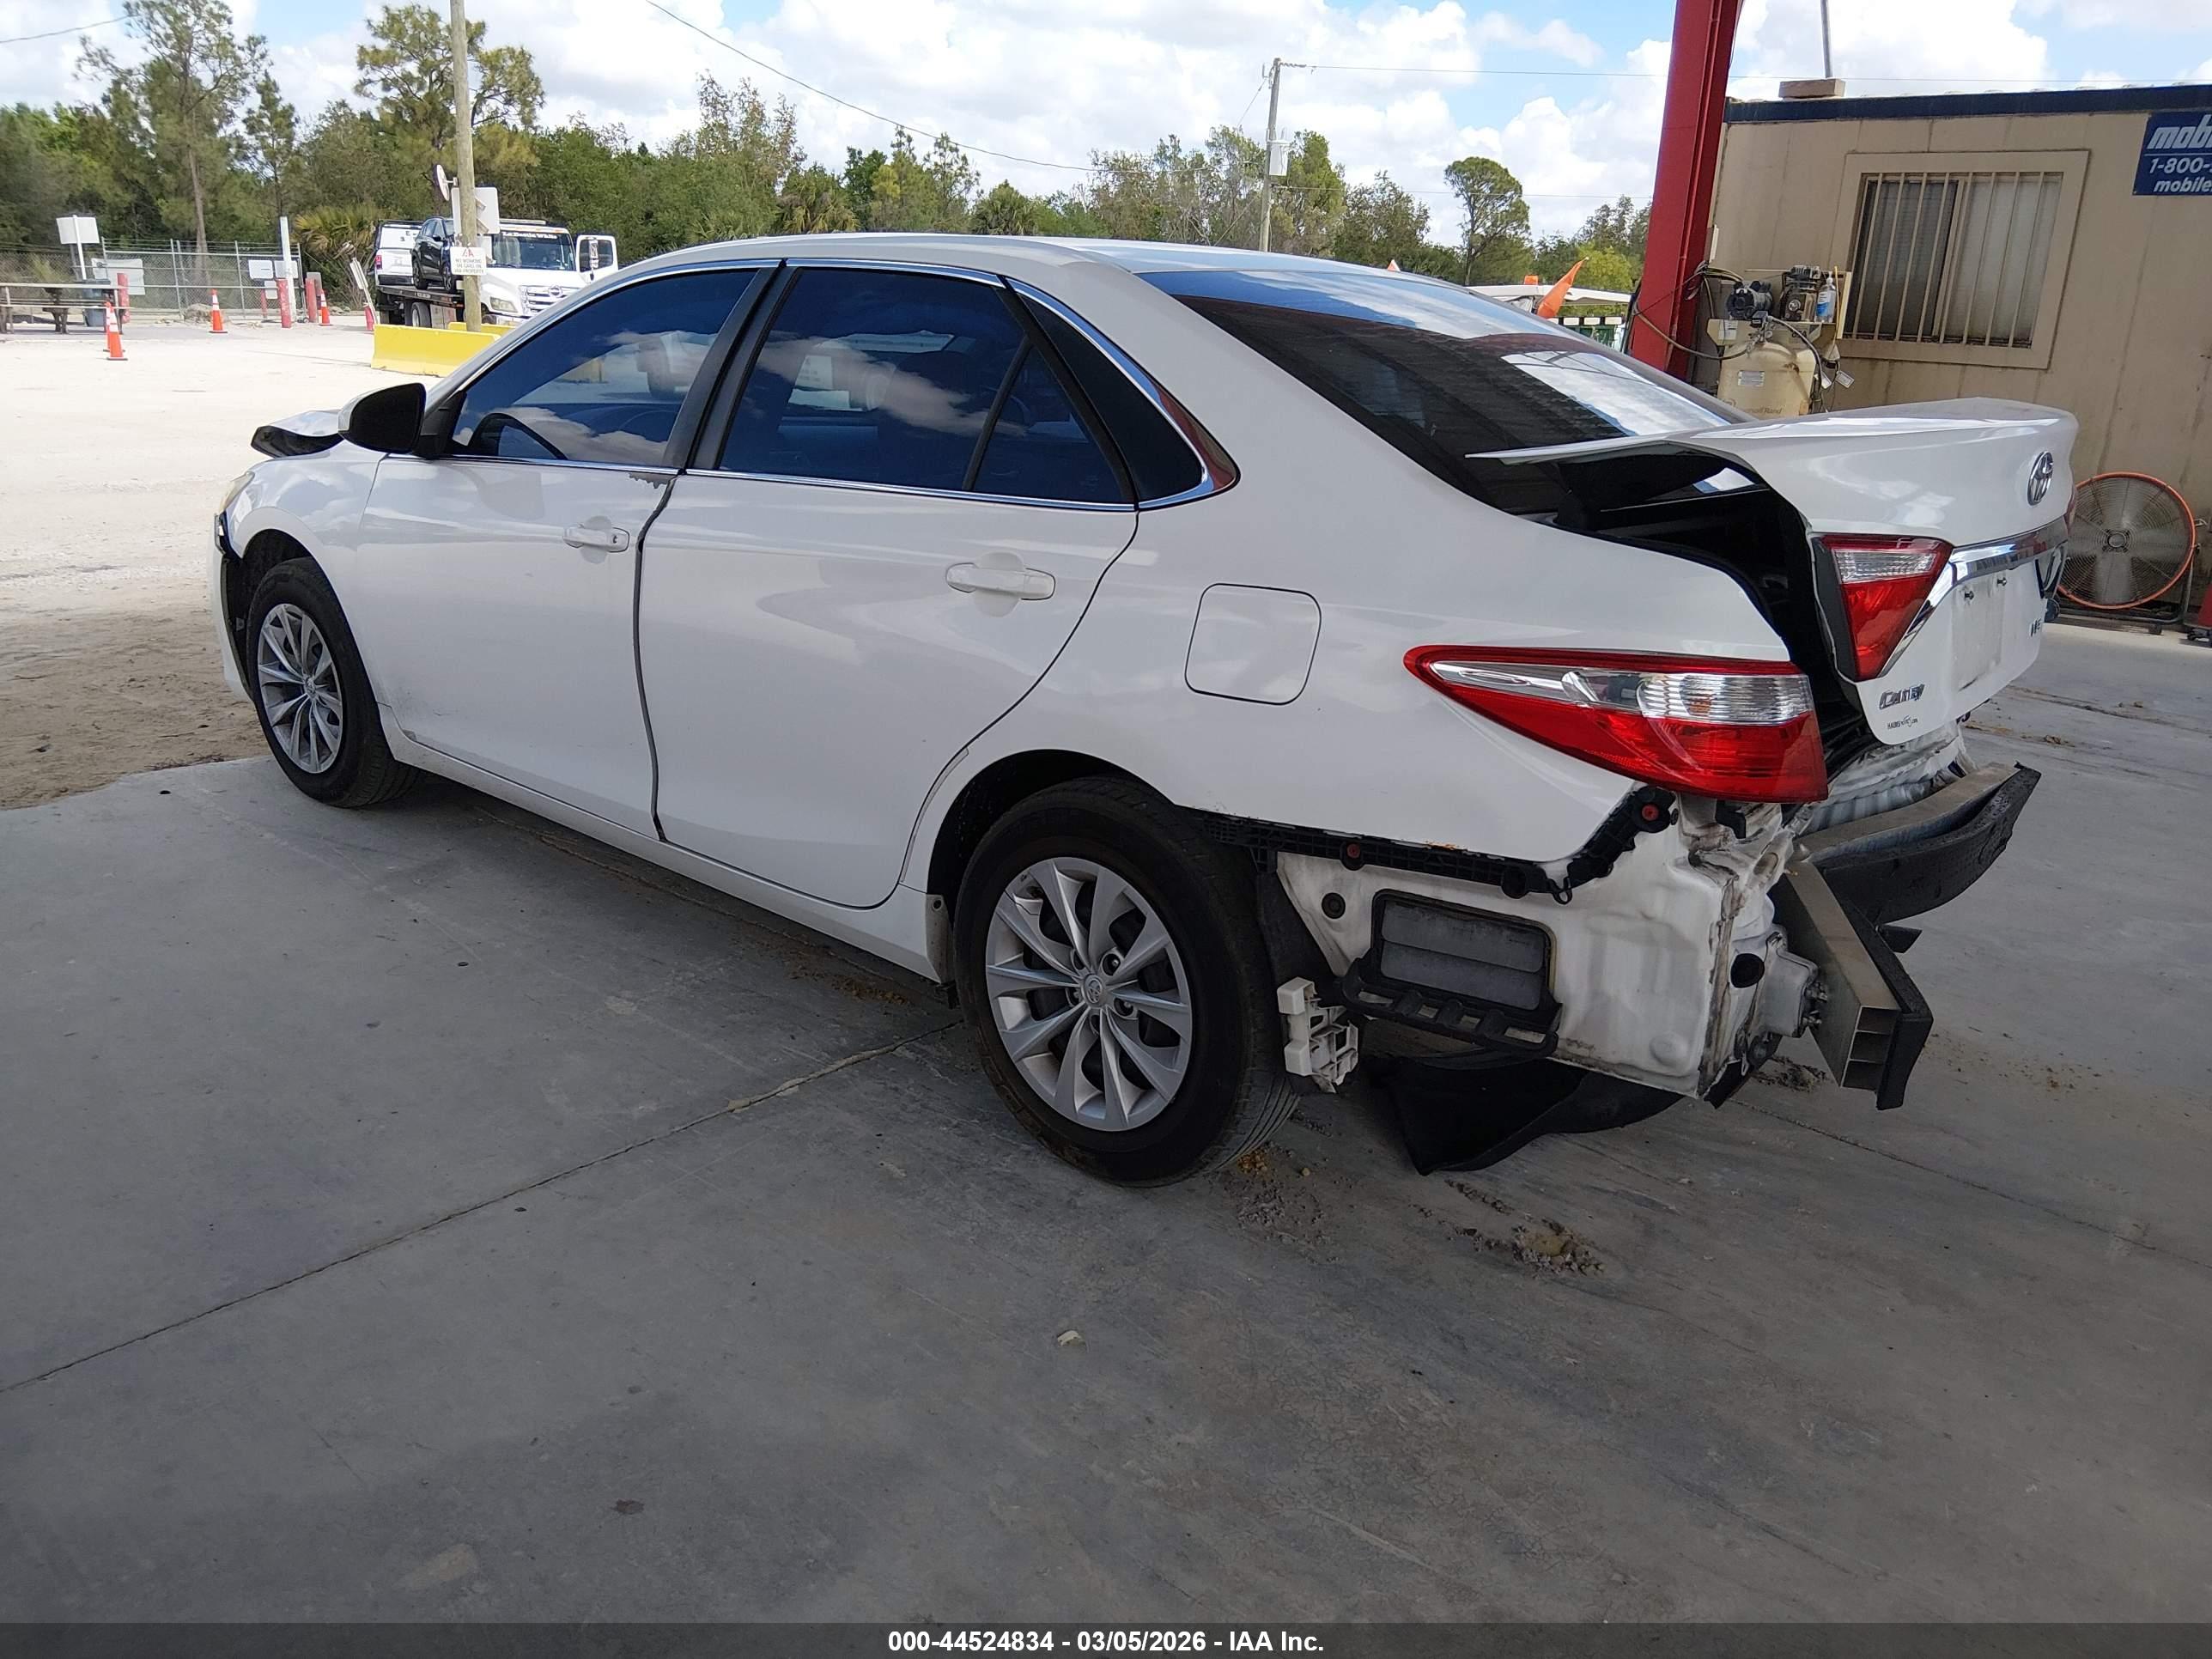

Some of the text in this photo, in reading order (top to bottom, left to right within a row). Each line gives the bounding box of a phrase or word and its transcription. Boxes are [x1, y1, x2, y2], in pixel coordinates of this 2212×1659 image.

[2147, 114, 2212, 149] mob
[2149, 157, 2212, 173] 1-800-
[2153, 177, 2212, 192] mobile
